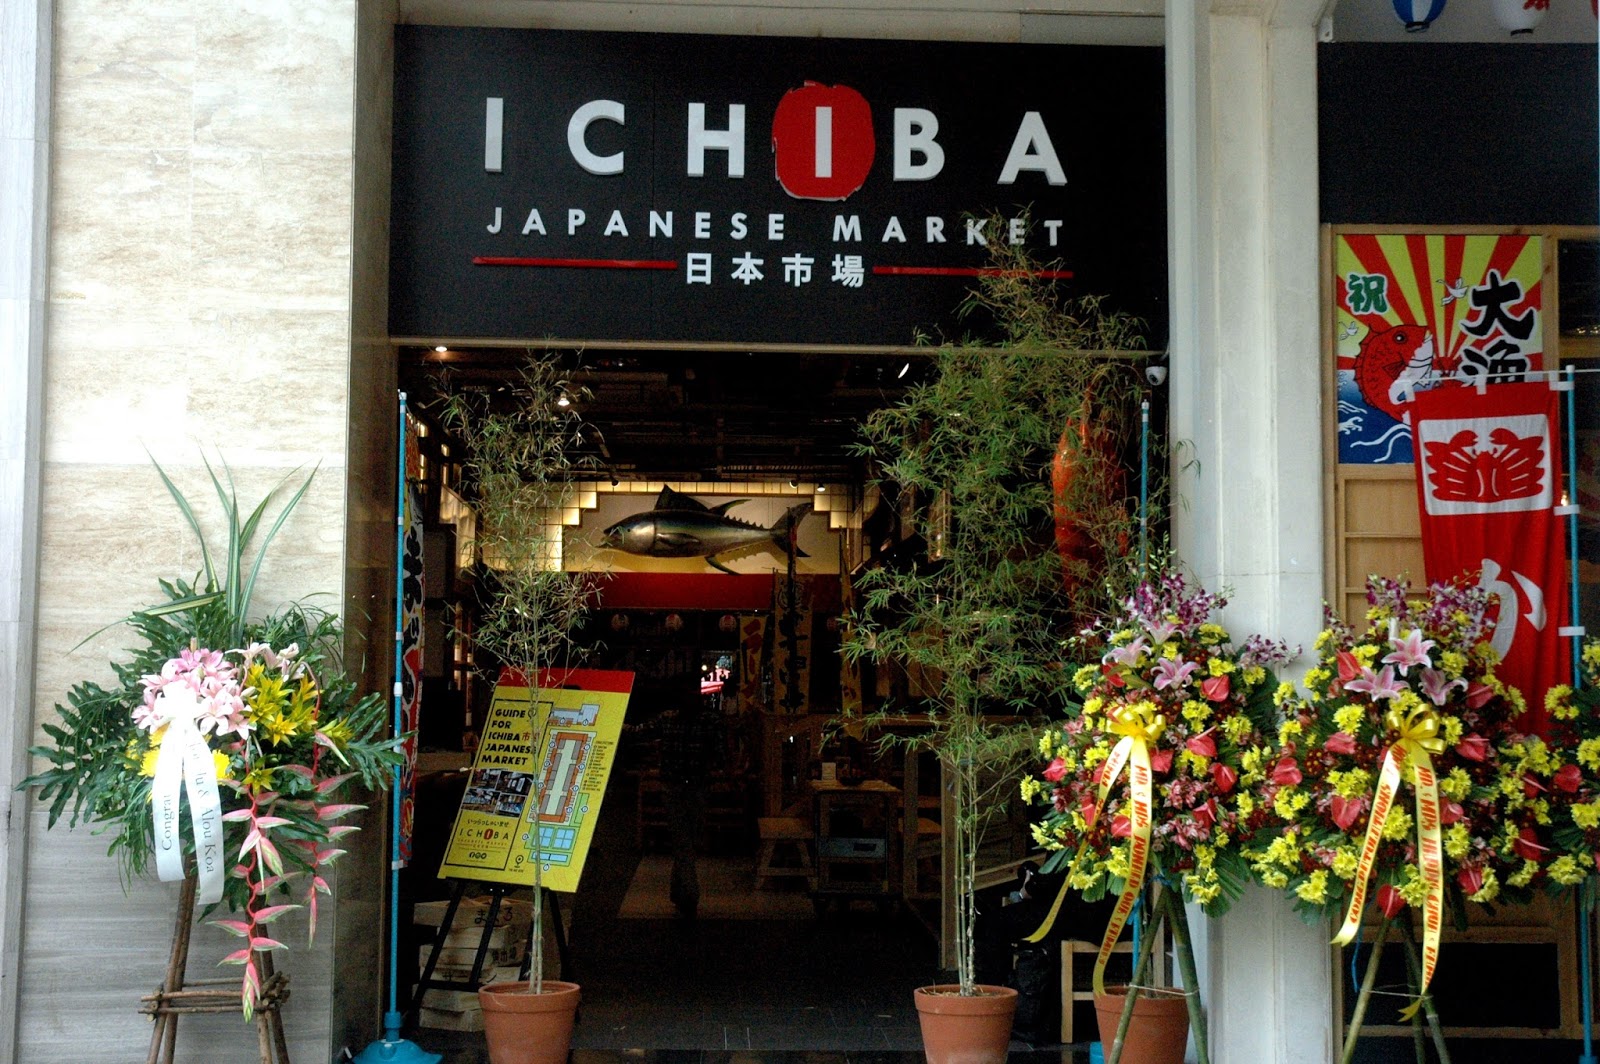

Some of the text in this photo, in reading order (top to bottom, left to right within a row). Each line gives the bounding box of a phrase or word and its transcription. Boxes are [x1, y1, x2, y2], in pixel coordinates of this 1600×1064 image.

[484, 97, 1068, 187] ICHIBA
[487, 207, 1064, 248] JAPANESE MARKET
[685, 252, 865, 289] 日本市場
[1347, 274, 1387, 313] 祝
[495, 709, 526, 718] GUIDE
[491, 720, 511, 729] FOR
[488, 732, 520, 741] ICHIBA
[481, 755, 528, 765] MARKET
[459, 828, 509, 841] ICHIBA
[205, 844, 216, 873] Koa
